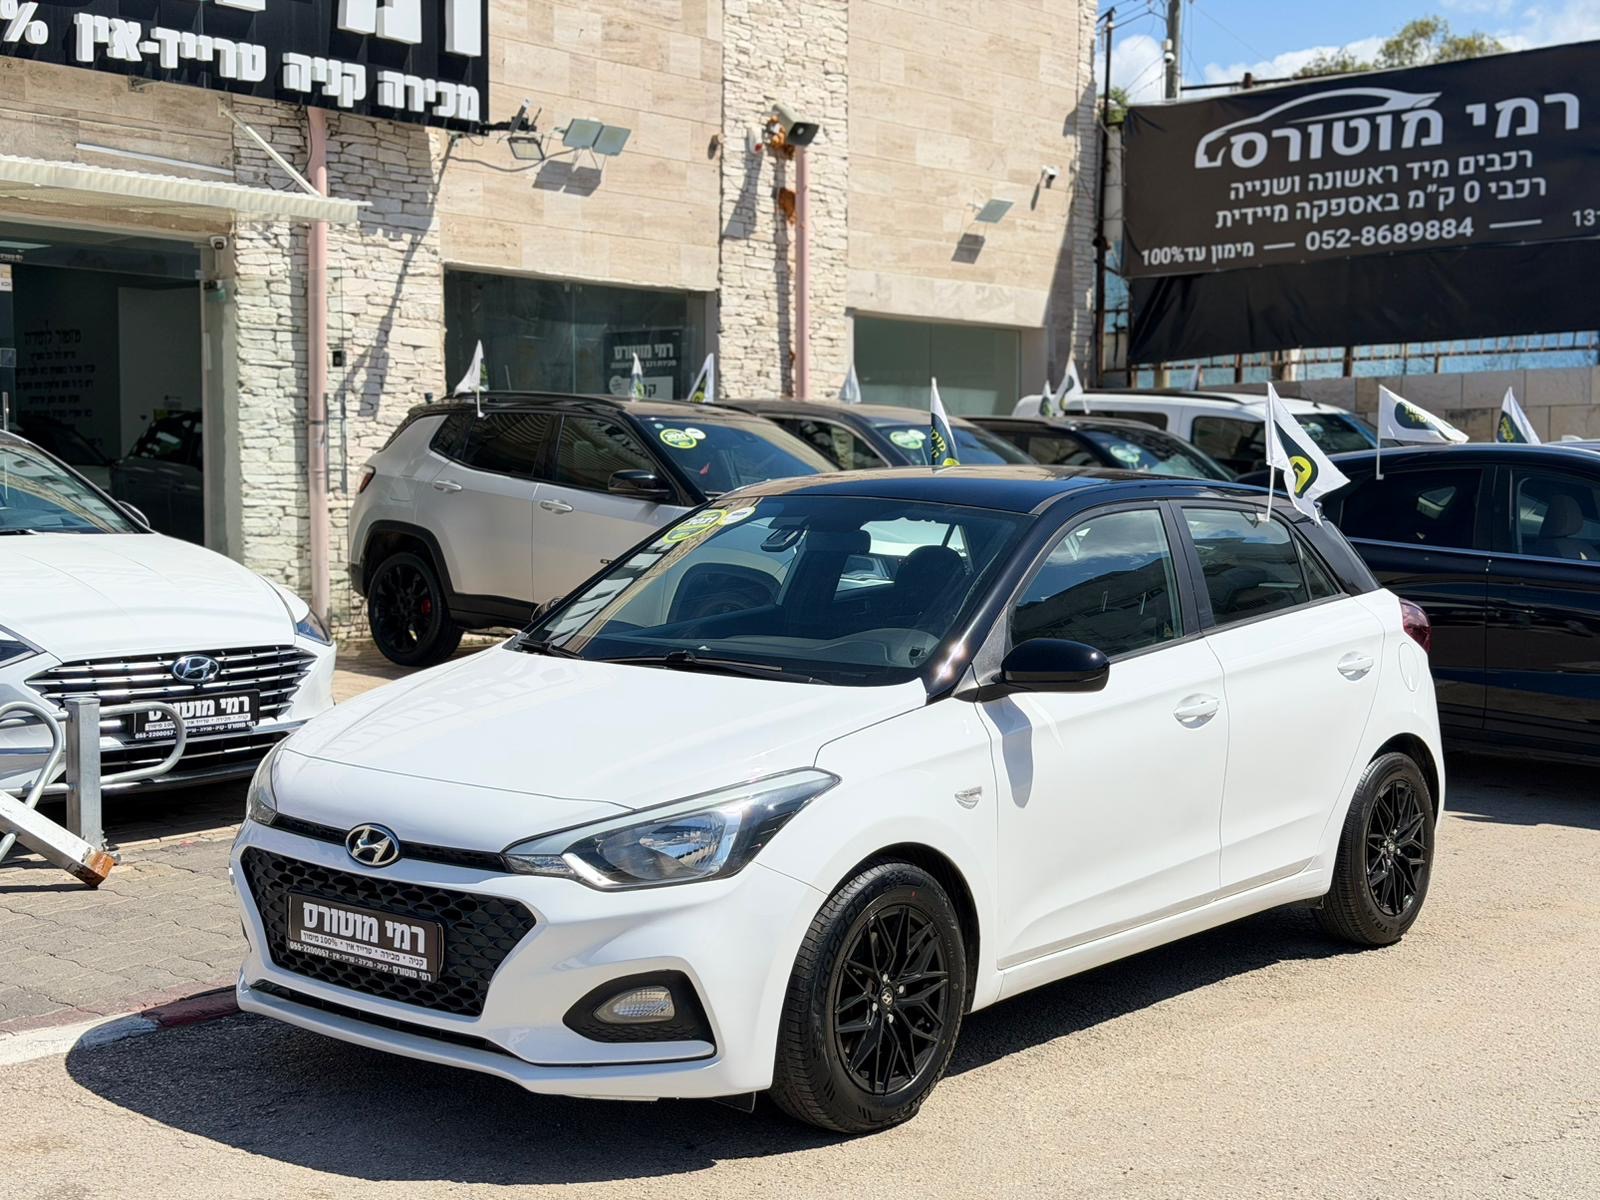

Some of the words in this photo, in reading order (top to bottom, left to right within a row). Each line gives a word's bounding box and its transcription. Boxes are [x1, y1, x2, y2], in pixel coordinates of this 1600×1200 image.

[282, 52, 367, 108] קניה
[378, 70, 480, 122] מכירה
[1466, 92, 1580, 139] רמי
[1230, 108, 1444, 169] מוטורס
[1406, 160, 1449, 182] מיד
[1458, 150, 1533, 175] רכבים
[1230, 177, 1301, 200] ושנייה
[1307, 166, 1399, 193] ראשונה
[1464, 180, 1481, 202] 0
[1490, 178, 1547, 200] רכבי
[1215, 202, 1289, 230] מיידית
[1295, 191, 1400, 223] באספקה
[1305, 216, 1475, 252] 052-8689884
[1211, 241, 1254, 264] מימון
[654, 343, 674, 358] רמי
[148, 699, 216, 721] מוטוס
[219, 696, 250, 713] רמי
[303, 902, 379, 944] מוטורס
[385, 920, 426, 954] רמי
